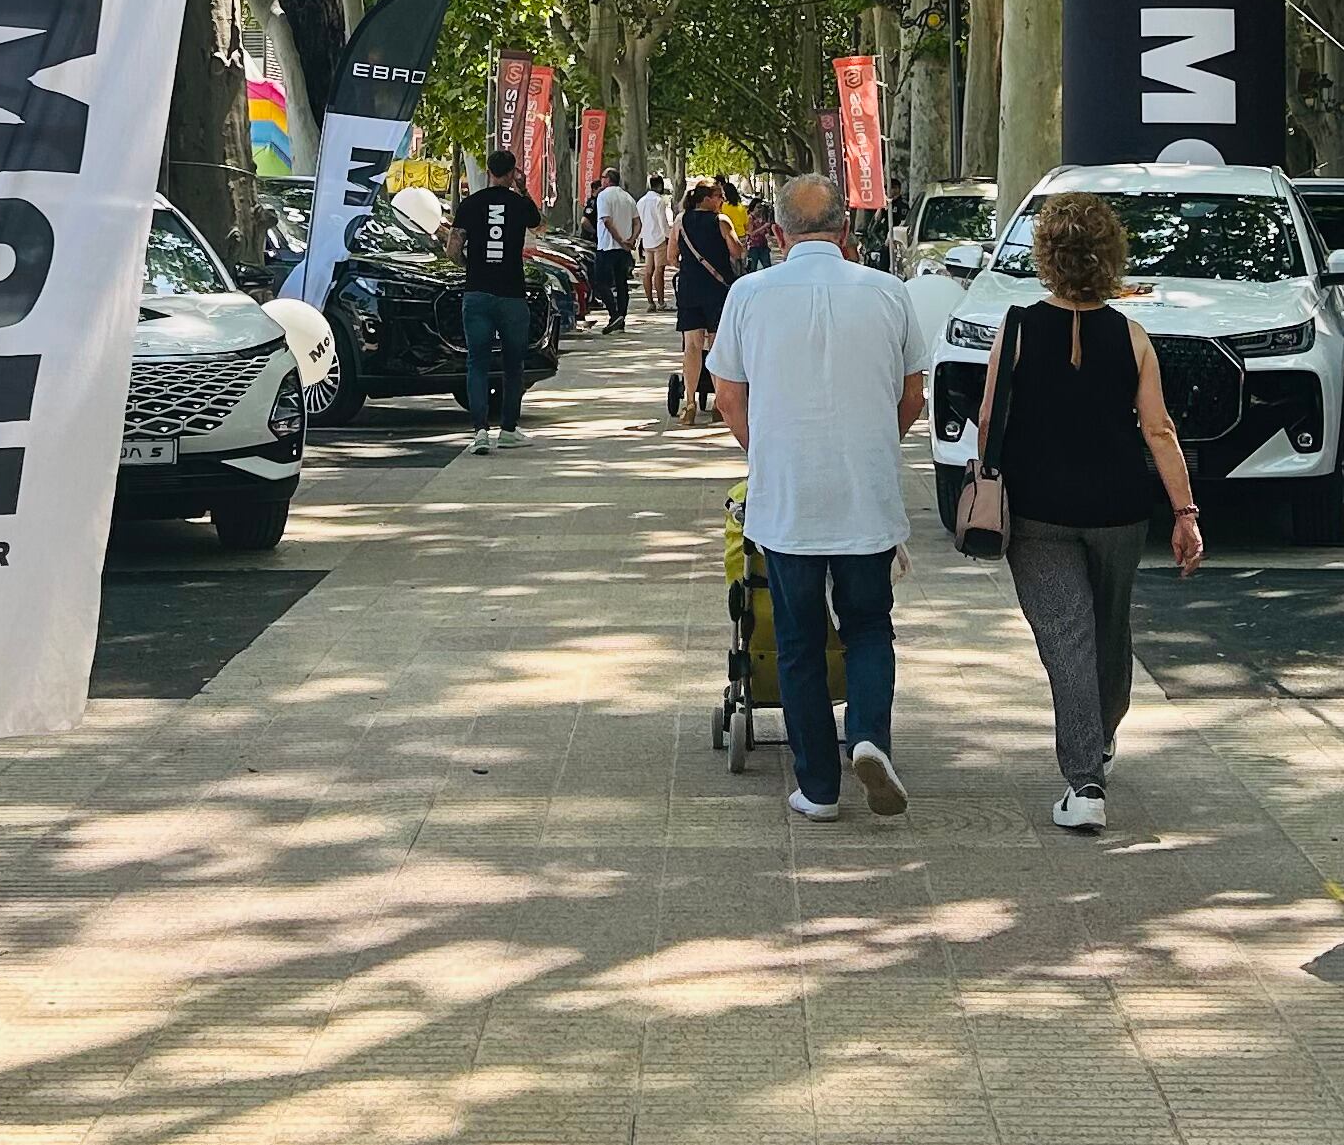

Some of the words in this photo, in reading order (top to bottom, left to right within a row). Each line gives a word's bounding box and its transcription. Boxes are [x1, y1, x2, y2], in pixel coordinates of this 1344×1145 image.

[353, 62, 427, 85] EBRO
[486, 204, 505, 259] Moll
[308, 331, 332, 364] Mo
[150, 447, 164, 458] S
